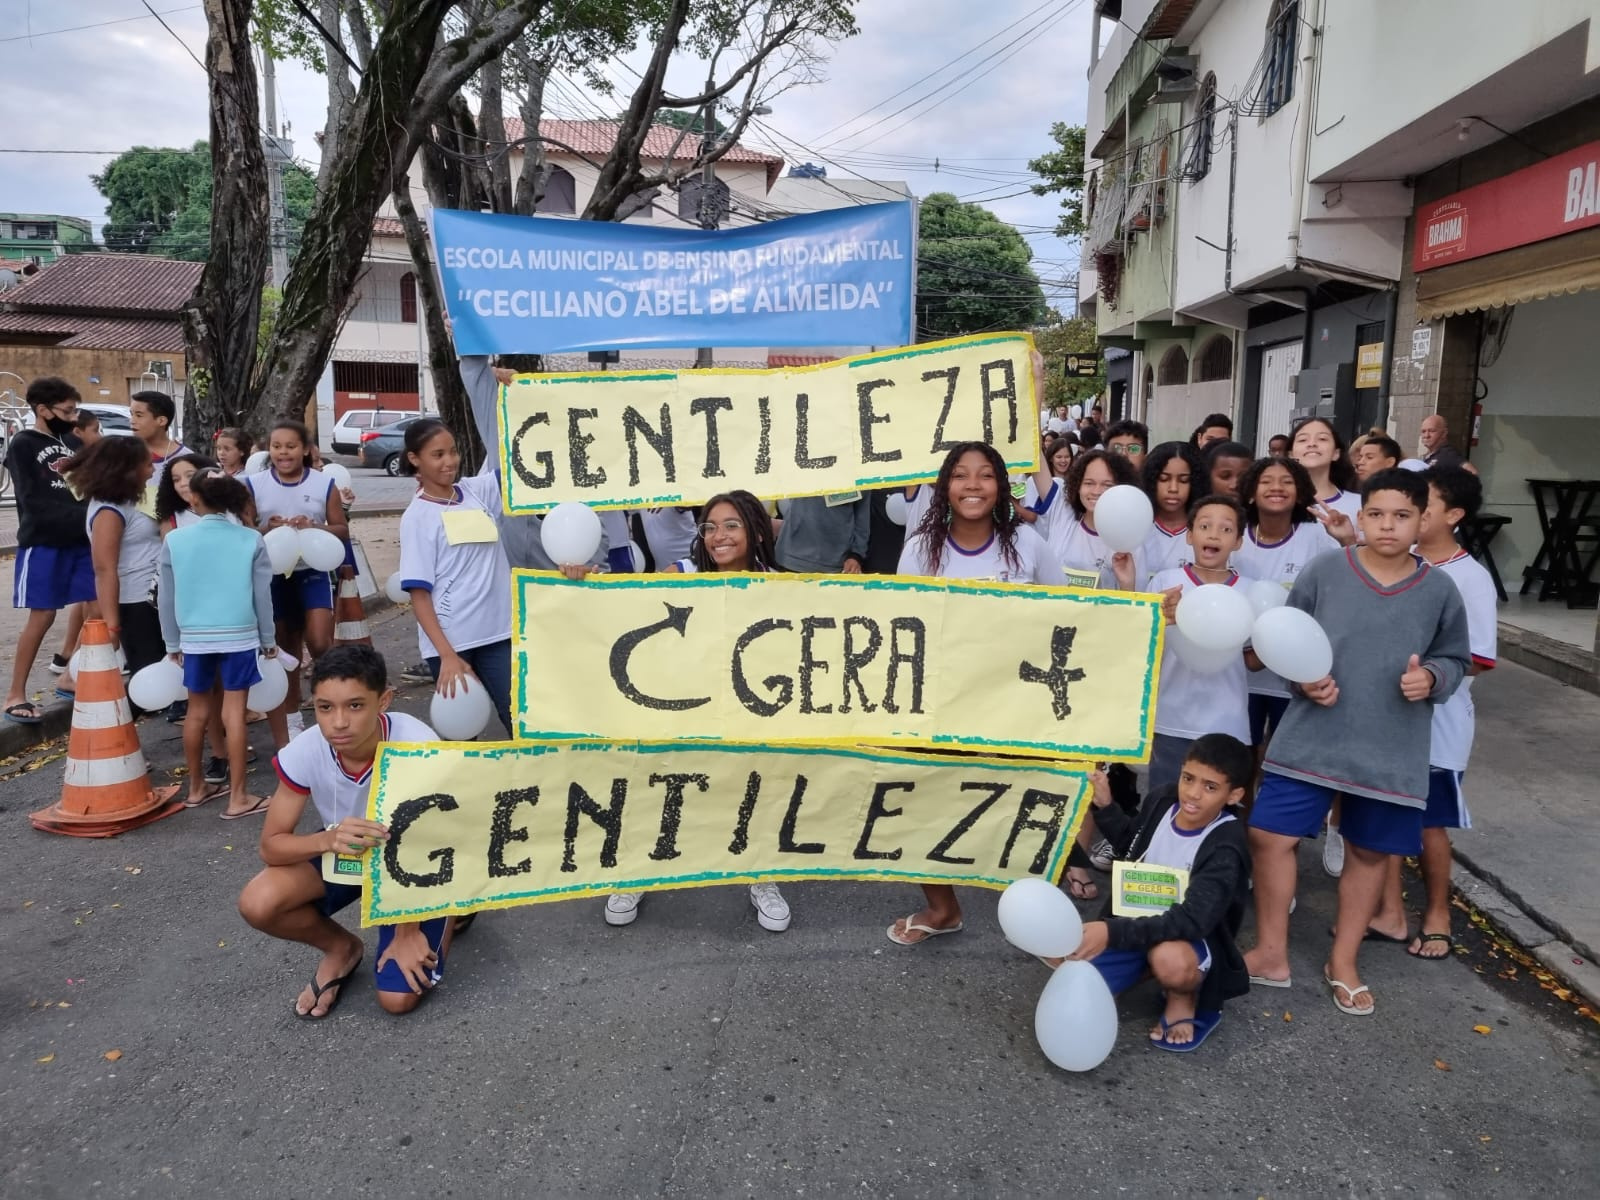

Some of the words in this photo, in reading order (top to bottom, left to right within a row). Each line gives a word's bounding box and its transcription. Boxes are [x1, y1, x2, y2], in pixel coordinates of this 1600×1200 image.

[1564, 161, 1600, 223] BA
[444, 247, 523, 270] ESCOLA
[528, 250, 639, 271] MUNICIPAL
[672, 250, 749, 270] ENSINO
[755, 240, 904, 269] FUNDAMENTAL
[1428, 216, 1463, 247] BRAHMA
[634, 288, 703, 317] ABEL
[710, 287, 746, 315] DE
[511, 359, 1018, 490] GENTILEZA
[731, 615, 927, 717] GERA
[384, 770, 1070, 889] GENTILEZA
